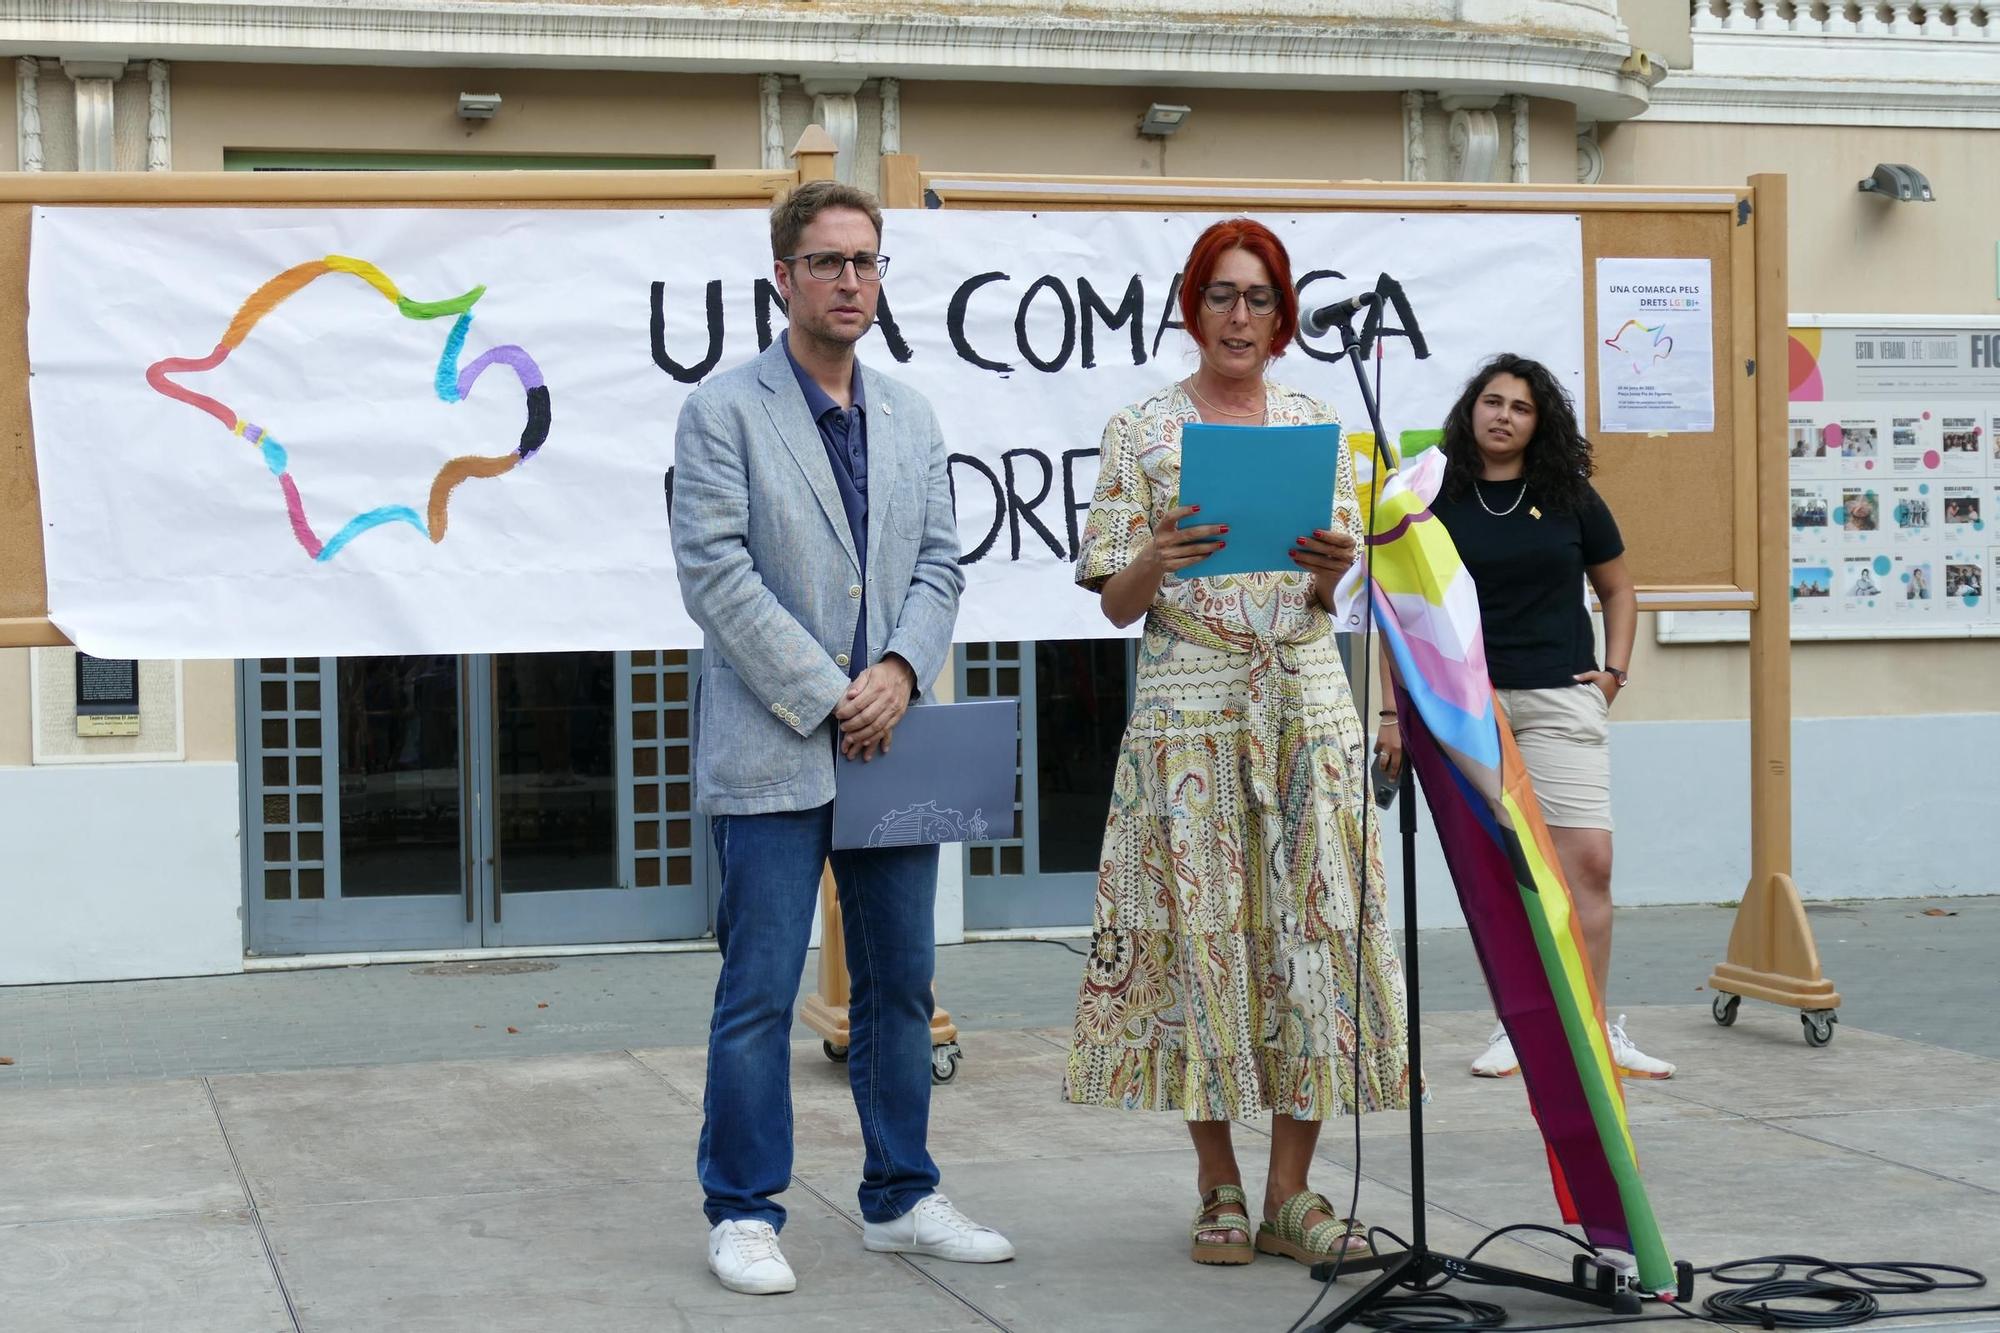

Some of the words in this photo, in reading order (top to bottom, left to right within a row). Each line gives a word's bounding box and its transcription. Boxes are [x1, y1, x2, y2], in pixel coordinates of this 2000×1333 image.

[1609, 285, 1630, 293] UNA
[1632, 285, 1677, 294] COMARCA
[1679, 286, 1700, 294] PELS
[1640, 299, 1667, 307] DRETS
[947, 270, 1432, 372] COMACA
[946, 447, 1102, 565] DRE
